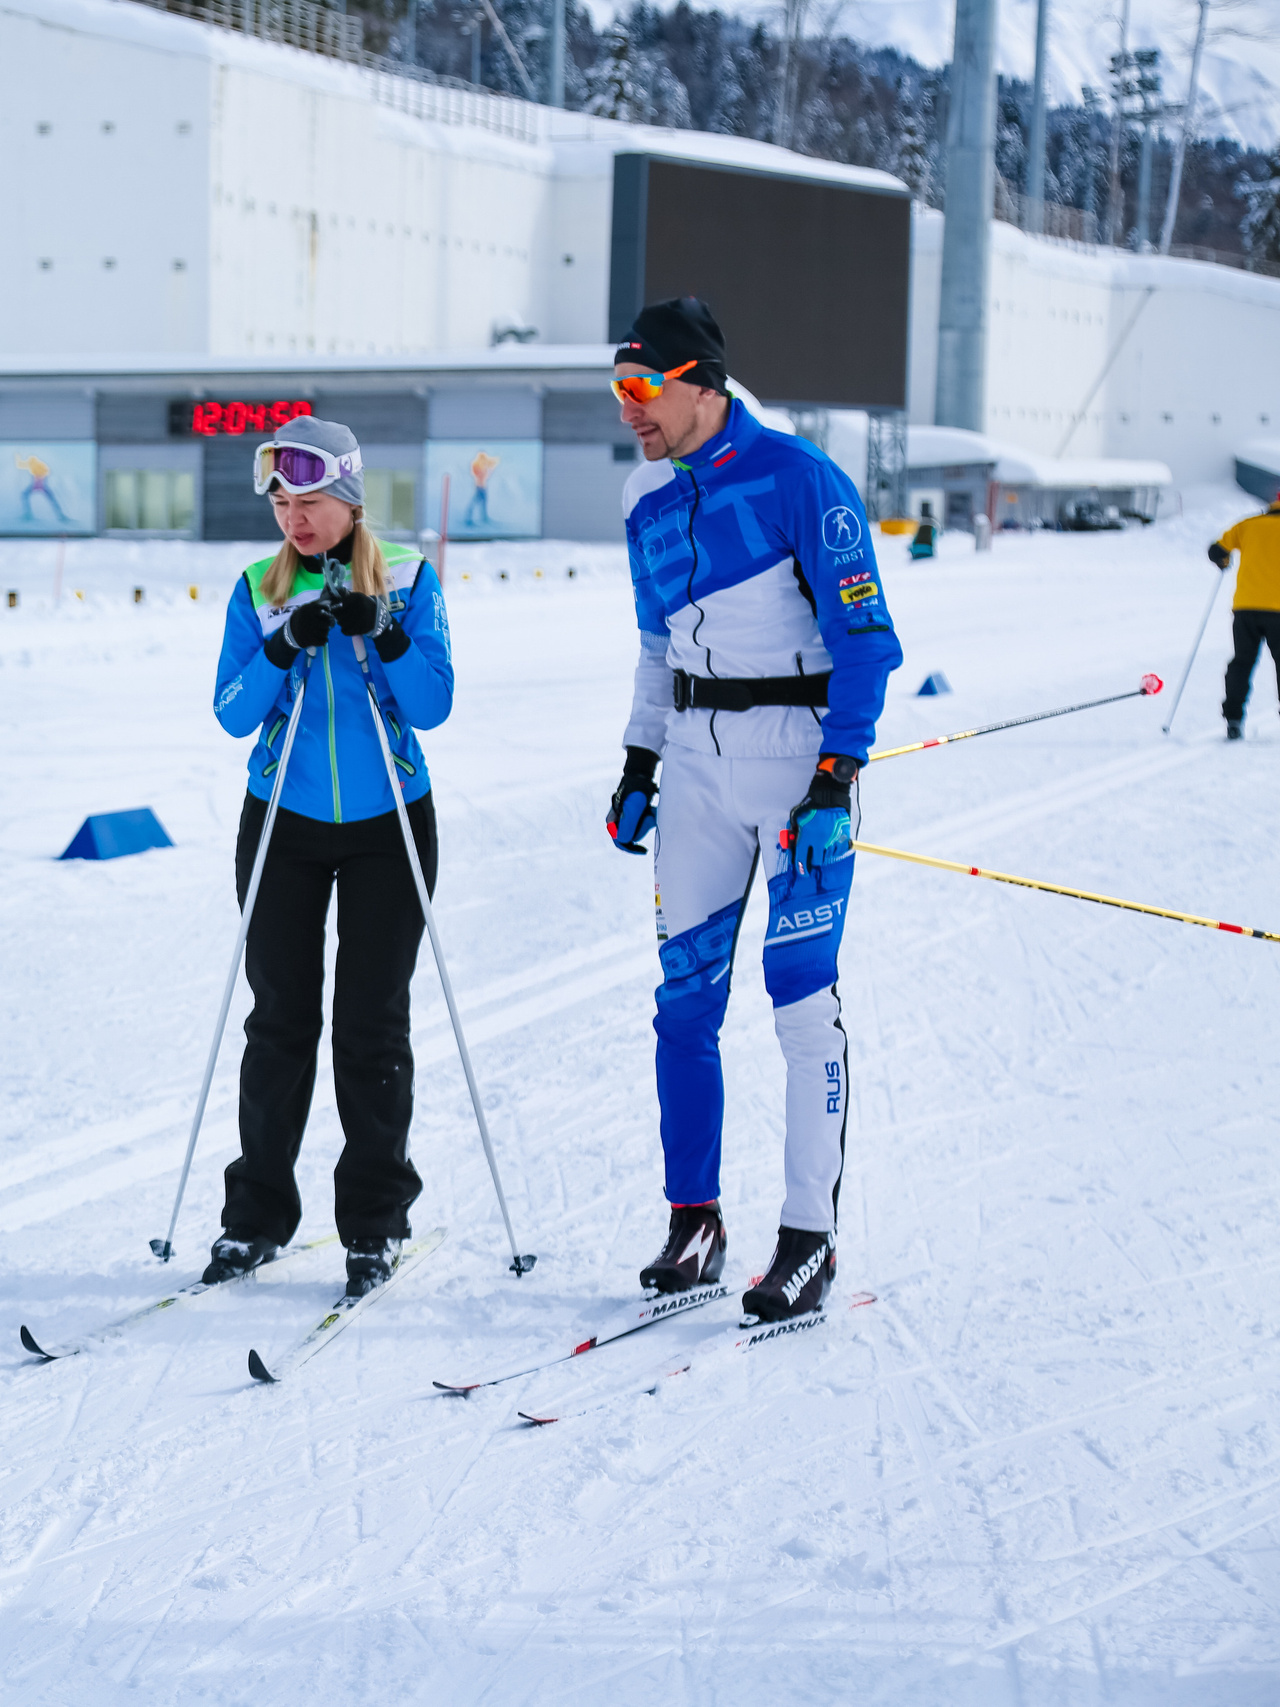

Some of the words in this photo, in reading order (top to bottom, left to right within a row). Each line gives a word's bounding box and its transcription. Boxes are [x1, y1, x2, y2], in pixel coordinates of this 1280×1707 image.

[834, 548, 864, 567] ABST
[776, 898, 845, 923] ABST
[825, 1061, 841, 1114] RUS
[652, 1286, 728, 1318] MADSHUS
[748, 1315, 827, 1346] MADSHUS
